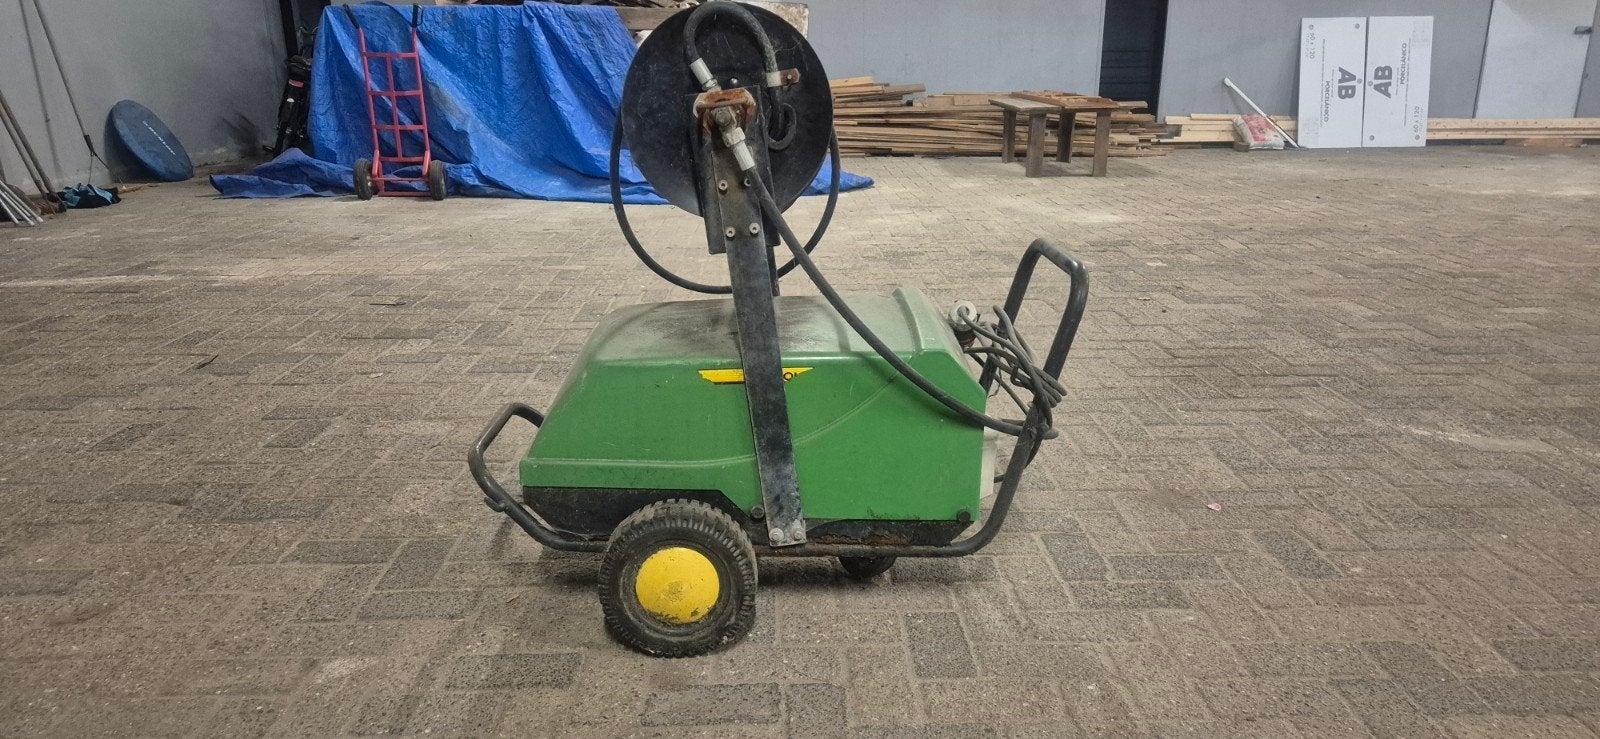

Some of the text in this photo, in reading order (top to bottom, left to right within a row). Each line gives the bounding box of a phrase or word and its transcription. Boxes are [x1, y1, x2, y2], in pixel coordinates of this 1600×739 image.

[1399, 42, 1407, 84] PORCELÁNICO
[1323, 80, 1331, 122] PORCELÁNICO
[1413, 124, 1419, 133] 60
